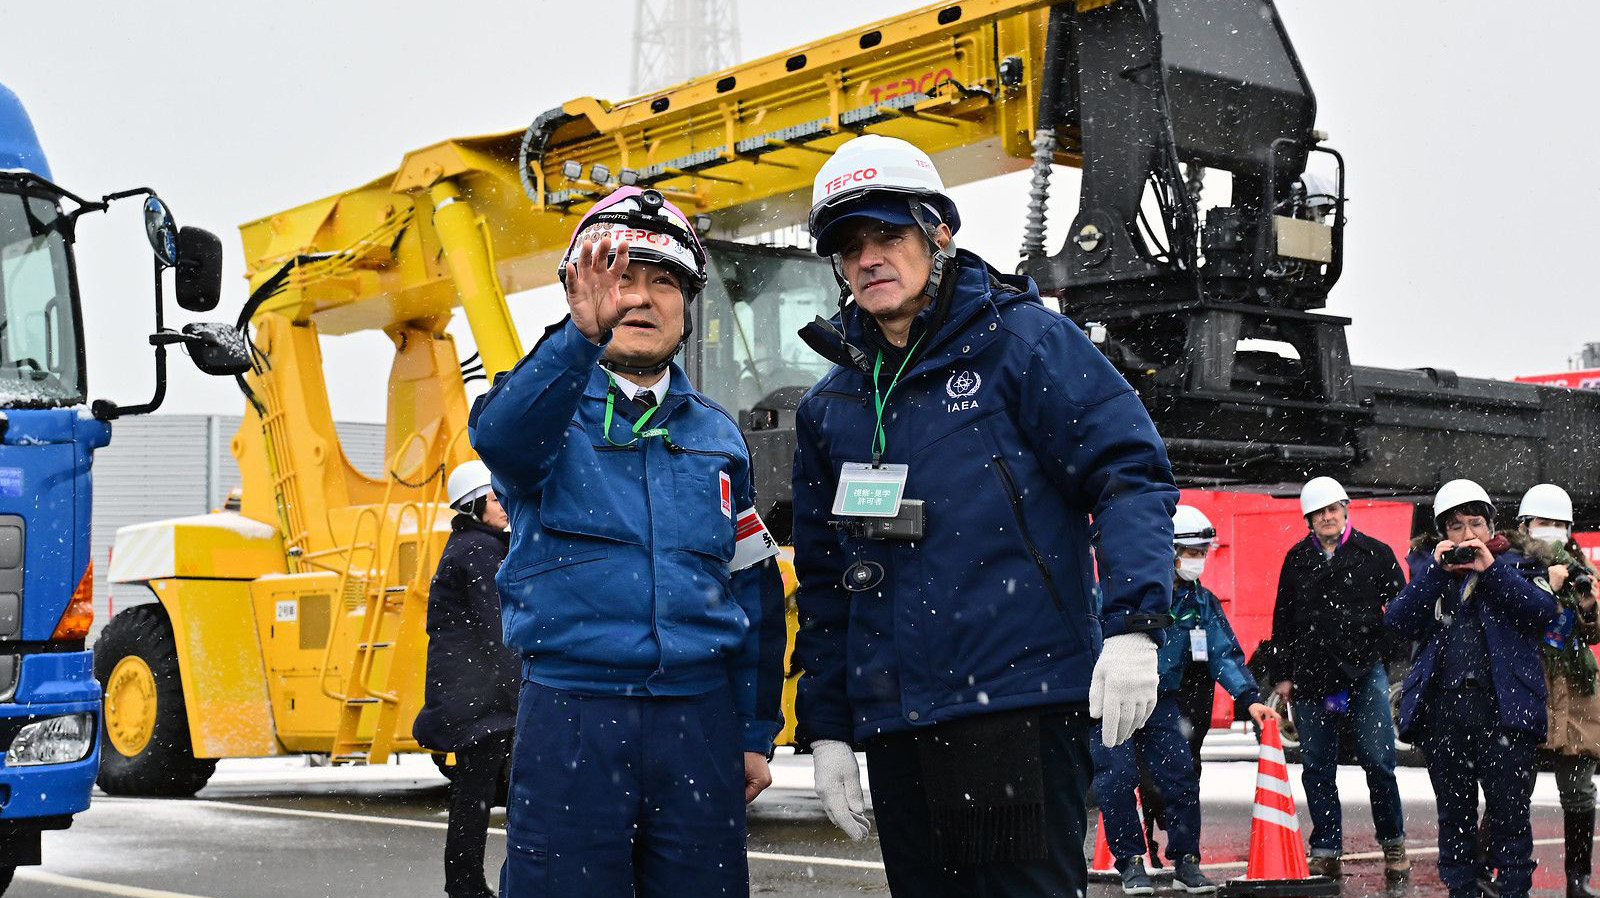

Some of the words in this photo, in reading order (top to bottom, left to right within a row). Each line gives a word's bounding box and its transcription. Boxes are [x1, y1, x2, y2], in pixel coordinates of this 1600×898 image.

[825, 168, 878, 194] TEPCO
[614, 229, 670, 246] TEPCO
[947, 400, 979, 413] IAEA
